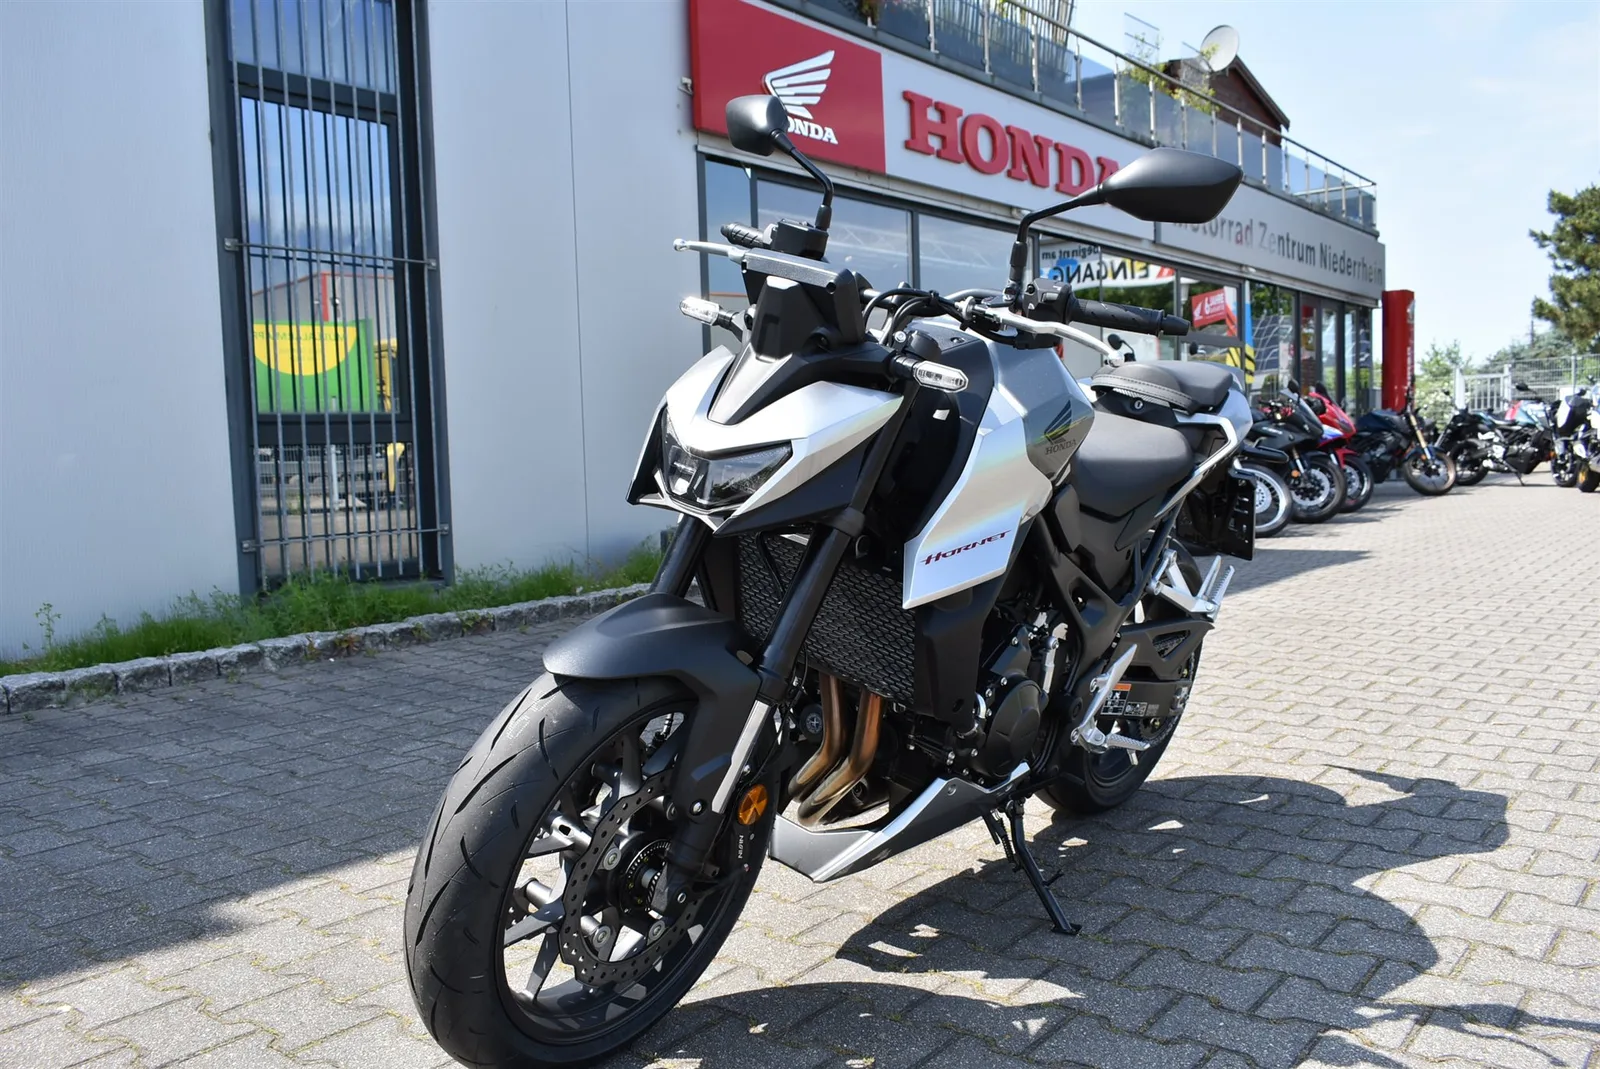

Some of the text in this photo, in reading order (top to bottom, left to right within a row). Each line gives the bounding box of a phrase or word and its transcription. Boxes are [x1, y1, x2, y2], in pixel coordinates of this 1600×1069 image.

[787, 115, 839, 145] ONDA
[1259, 221, 1316, 267] Zentrum
[1319, 242, 1383, 285] Niederrhein
[1045, 440, 1077, 455] HONDA
[920, 530, 1011, 565] HORNET
